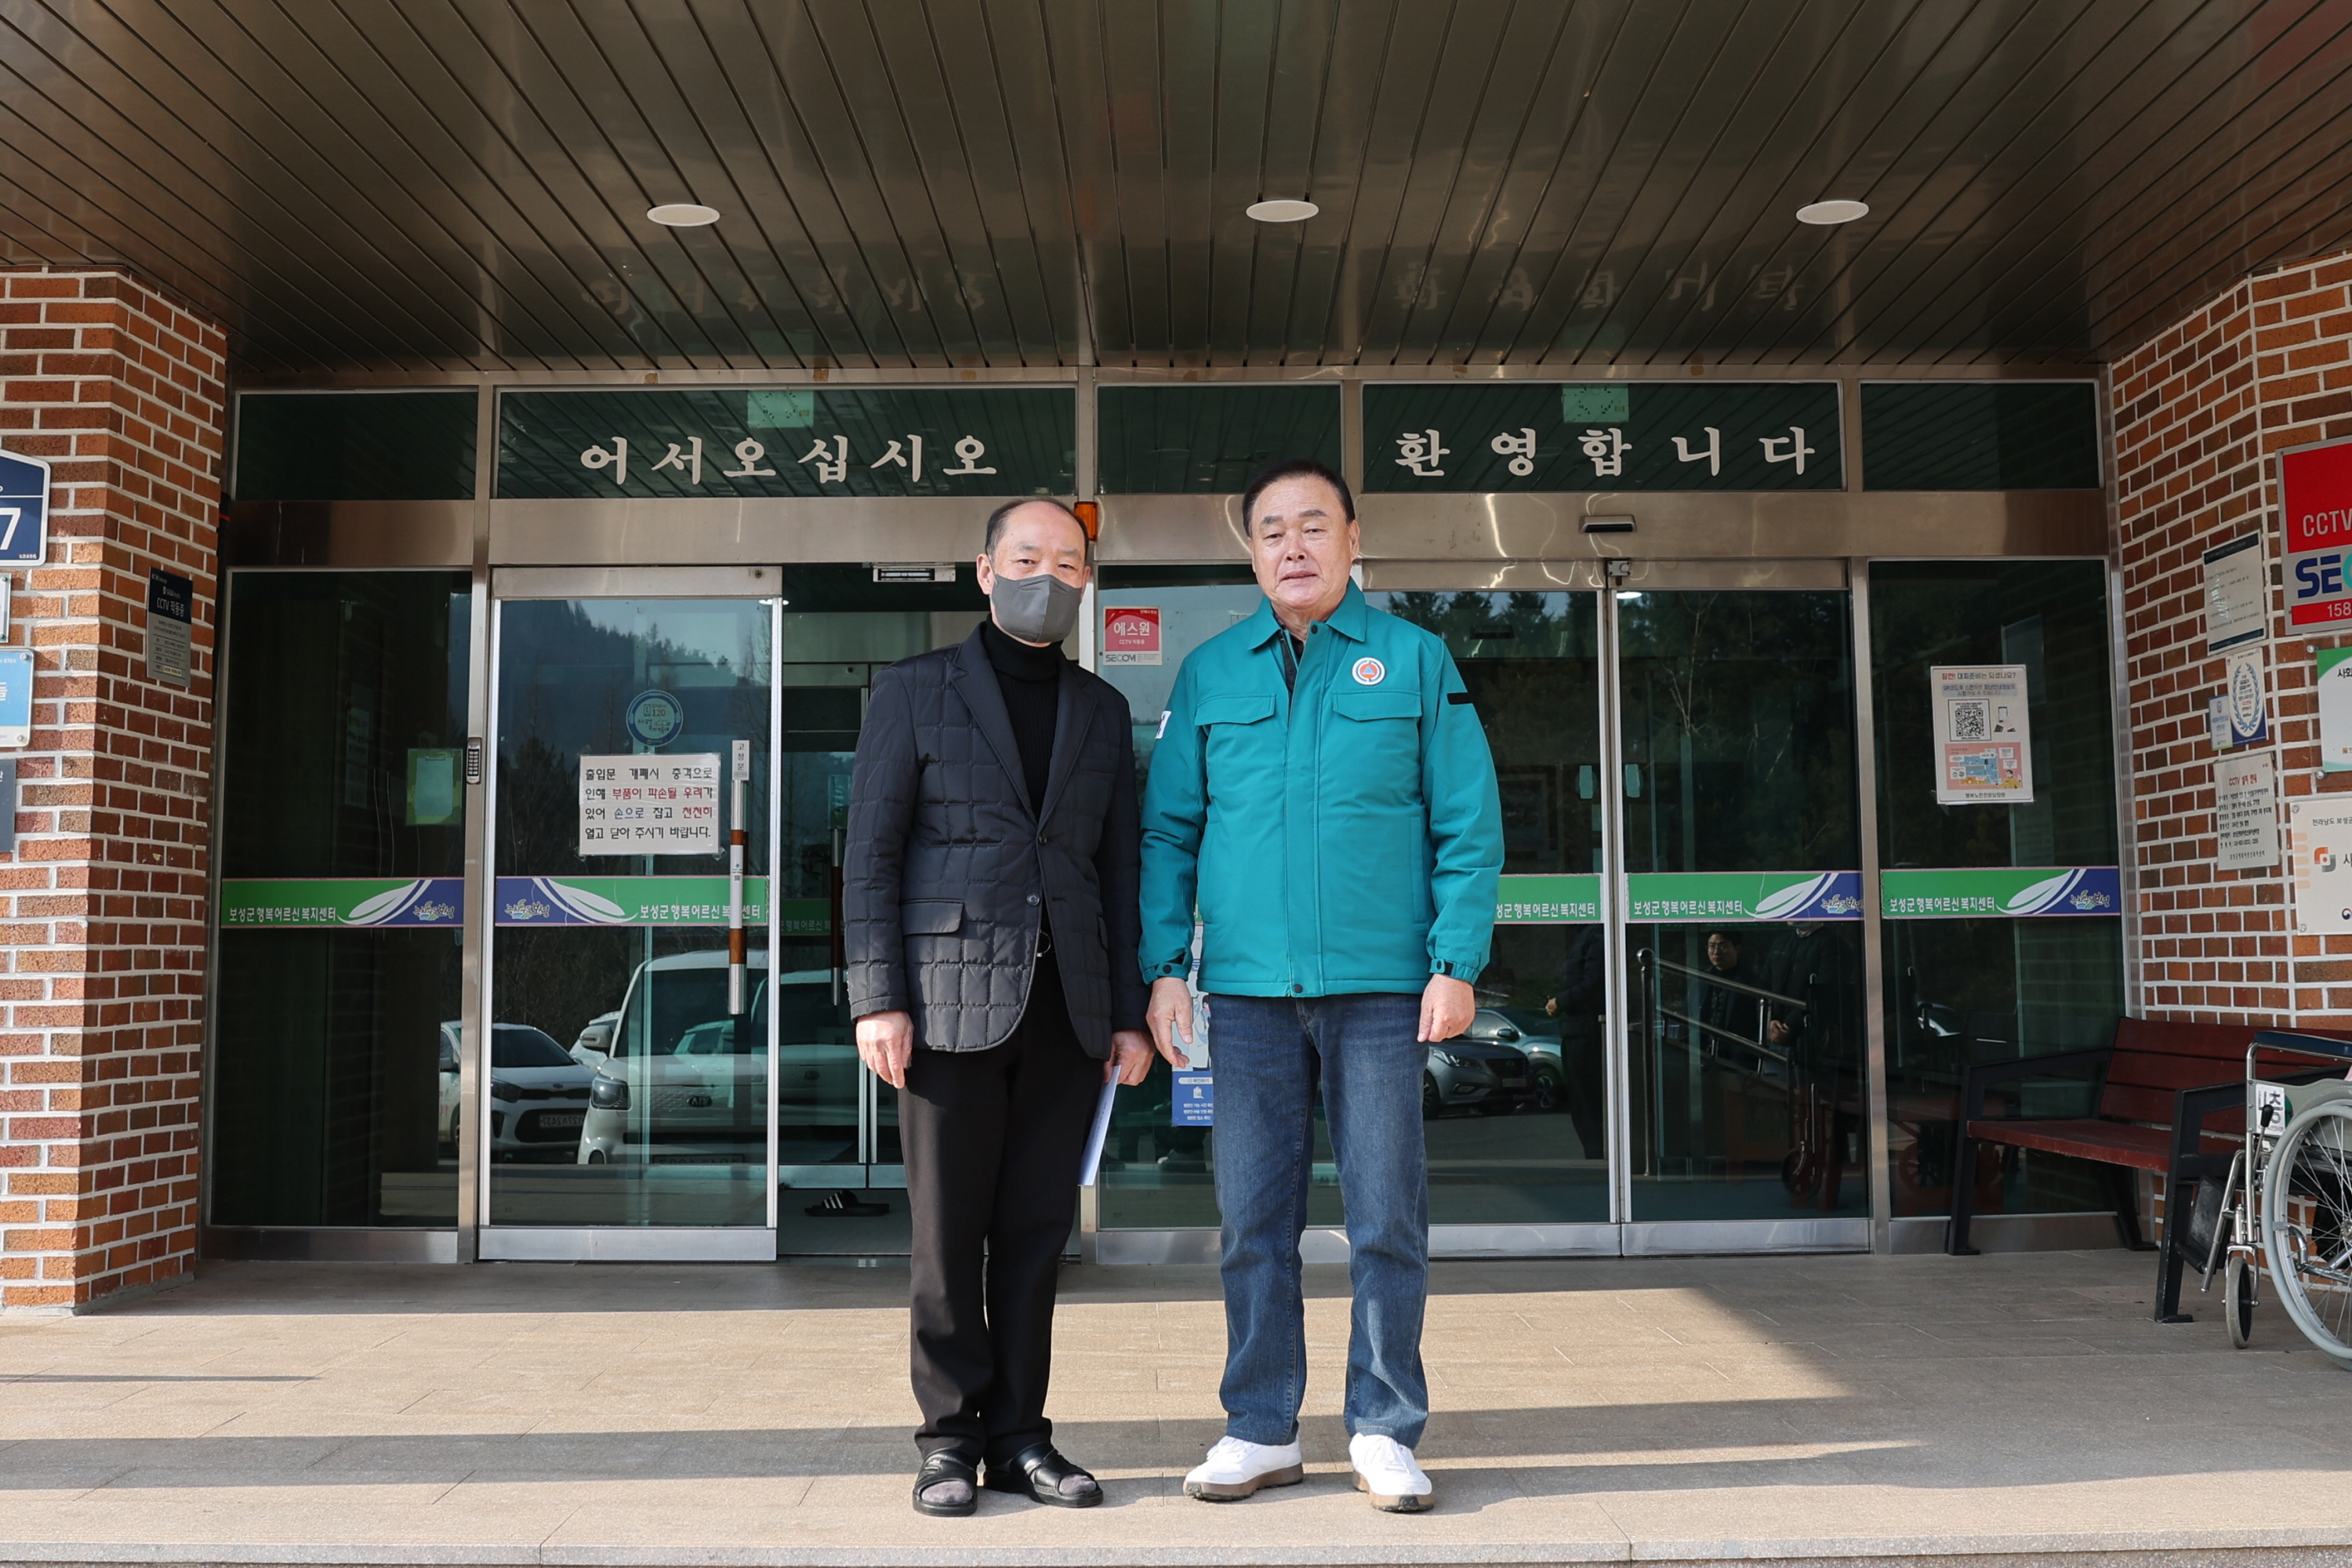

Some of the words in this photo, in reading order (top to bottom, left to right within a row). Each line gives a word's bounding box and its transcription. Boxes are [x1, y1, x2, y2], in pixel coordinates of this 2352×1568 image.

[580, 434, 996, 485] 어서오십시오
[1396, 427, 1815, 477] 환영합니다
[2303, 508, 2352, 537] CCTV
[1113, 622, 1149, 636] 에스원
[586, 768, 615, 781] 출입문
[629, 768, 659, 780] 개폐시
[672, 768, 712, 779] 충격으로
[586, 788, 605, 800] 인해
[612, 788, 641, 800] 부품이
[648, 787, 677, 800] 파손될
[683, 786, 713, 799] 우려가
[586, 808, 605, 820] 있어
[614, 808, 644, 819] 손으로
[653, 807, 673, 819] 잡고
[682, 806, 712, 818] 천천히
[586, 827, 604, 840] 열고
[610, 826, 630, 839] 닫아
[635, 826, 664, 839] 주시기
[670, 826, 711, 838] 바랍니다.
[641, 905, 668, 920] 보성군
[722, 905, 760, 919] 복센터
[1496, 903, 1512, 919] 성군
[1561, 902, 1595, 917] 복지센터
[1634, 901, 1660, 917] 보성군
[1708, 900, 1743, 916] 복지센터
[1890, 898, 1915, 913] 보성군
[1961, 897, 1994, 911] 복지센터
[230, 907, 255, 923] 보성군
[302, 907, 336, 922] 복지센터
